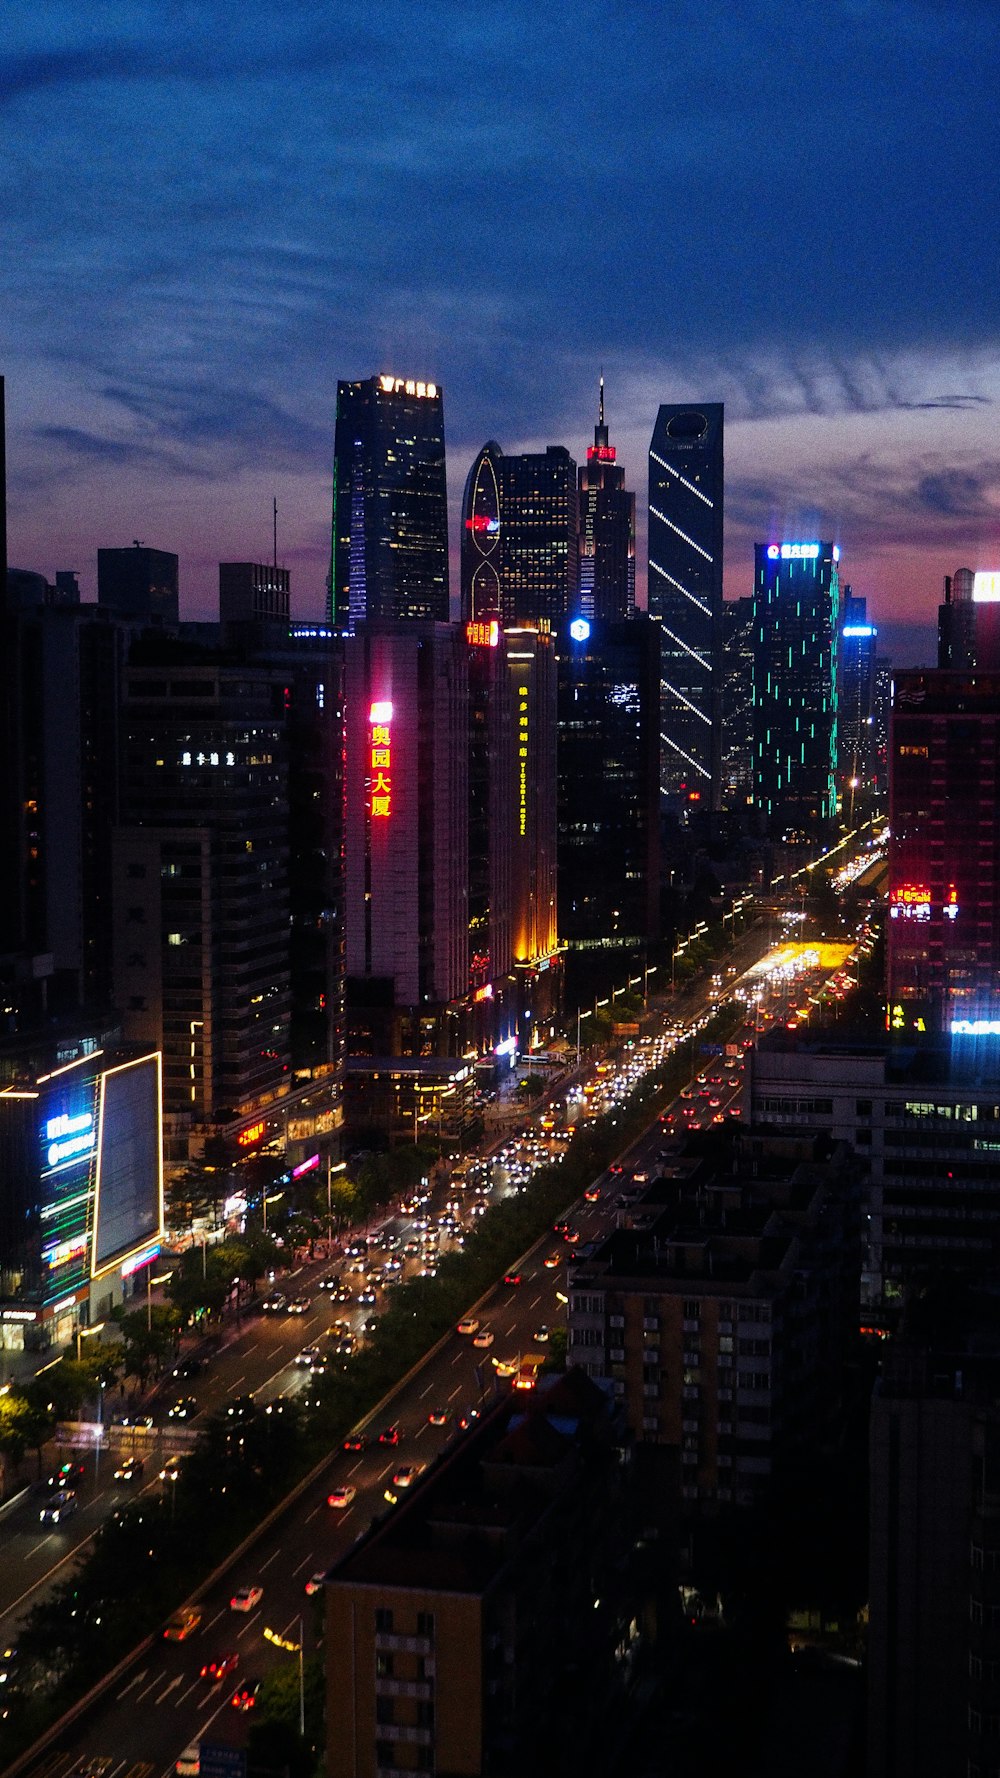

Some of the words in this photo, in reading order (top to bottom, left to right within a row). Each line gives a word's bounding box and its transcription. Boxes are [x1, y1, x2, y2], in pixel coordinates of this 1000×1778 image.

[395, 379, 437, 398] 广州
[371, 725, 392, 817] 奥园大厦
